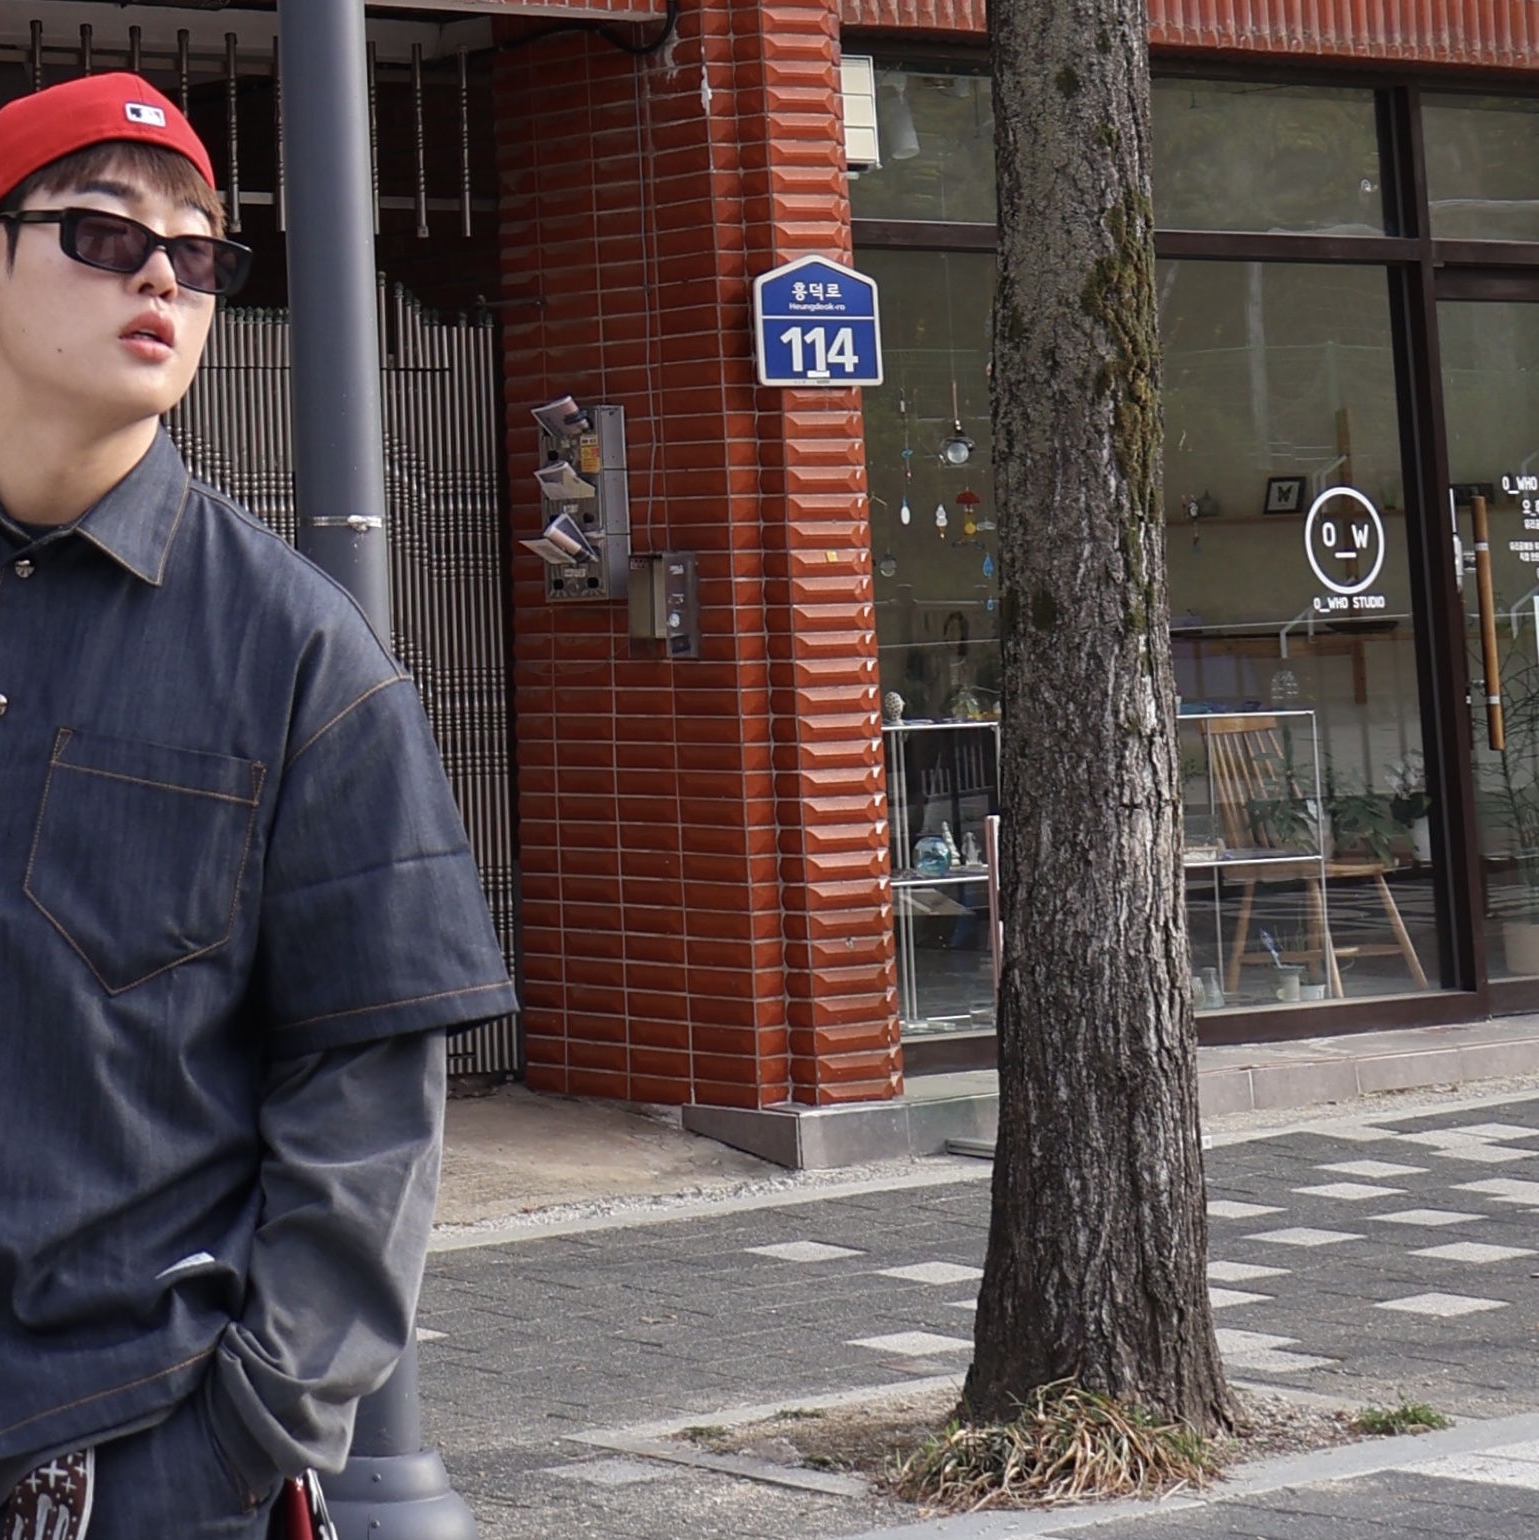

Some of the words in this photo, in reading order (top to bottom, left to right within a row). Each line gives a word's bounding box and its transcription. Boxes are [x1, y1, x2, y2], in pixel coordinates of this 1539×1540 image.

[791, 281, 843, 301] 흥덕로
[789, 302, 846, 312] Heungdeok-ro
[779, 326, 859, 373] 114
[1501, 476, 1539, 495] O_WHO
[1313, 596, 1349, 612] O_WHO
[1352, 596, 1386, 609] STUDIO
